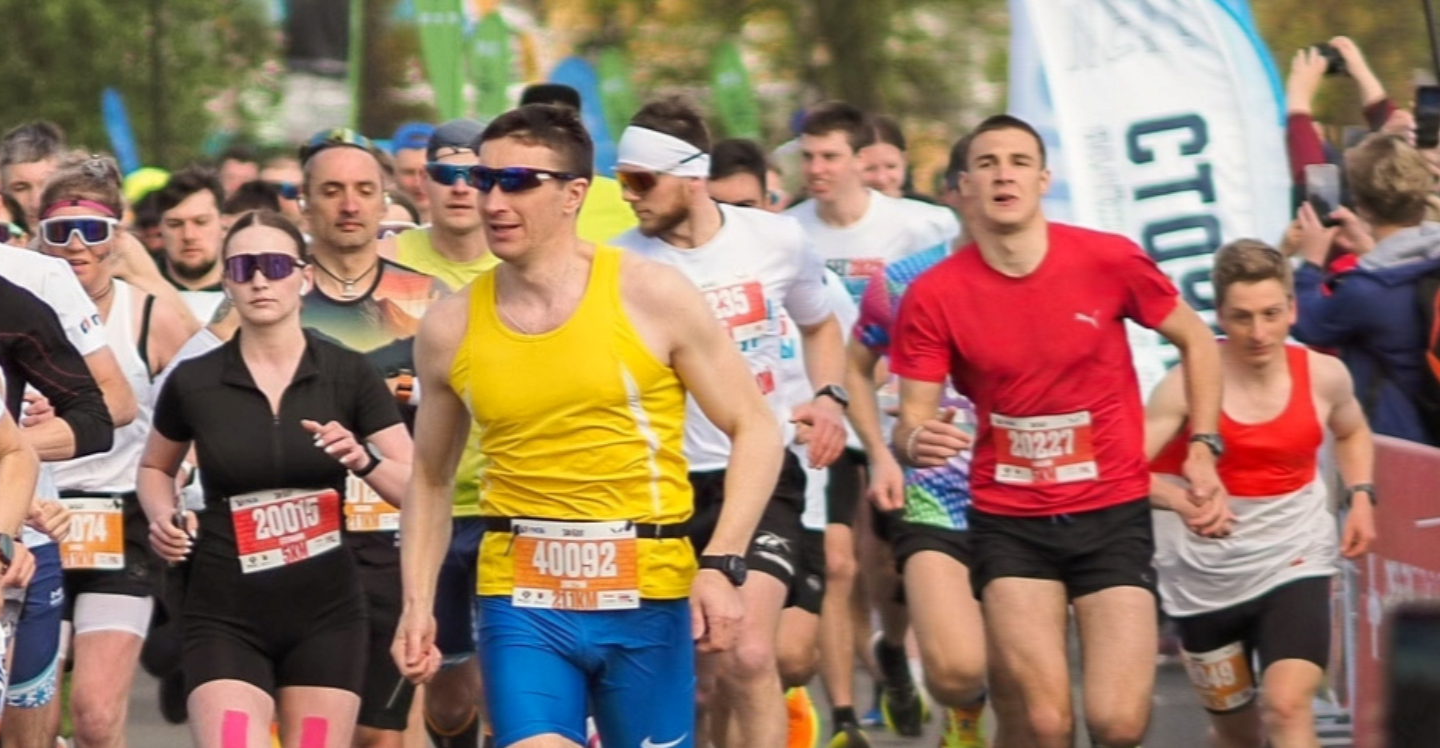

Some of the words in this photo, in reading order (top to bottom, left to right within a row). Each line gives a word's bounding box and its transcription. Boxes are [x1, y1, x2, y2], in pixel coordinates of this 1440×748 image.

[1007, 428, 1074, 459] 20227
[252, 497, 320, 540] 20015
[533, 541, 617, 578] 40092
